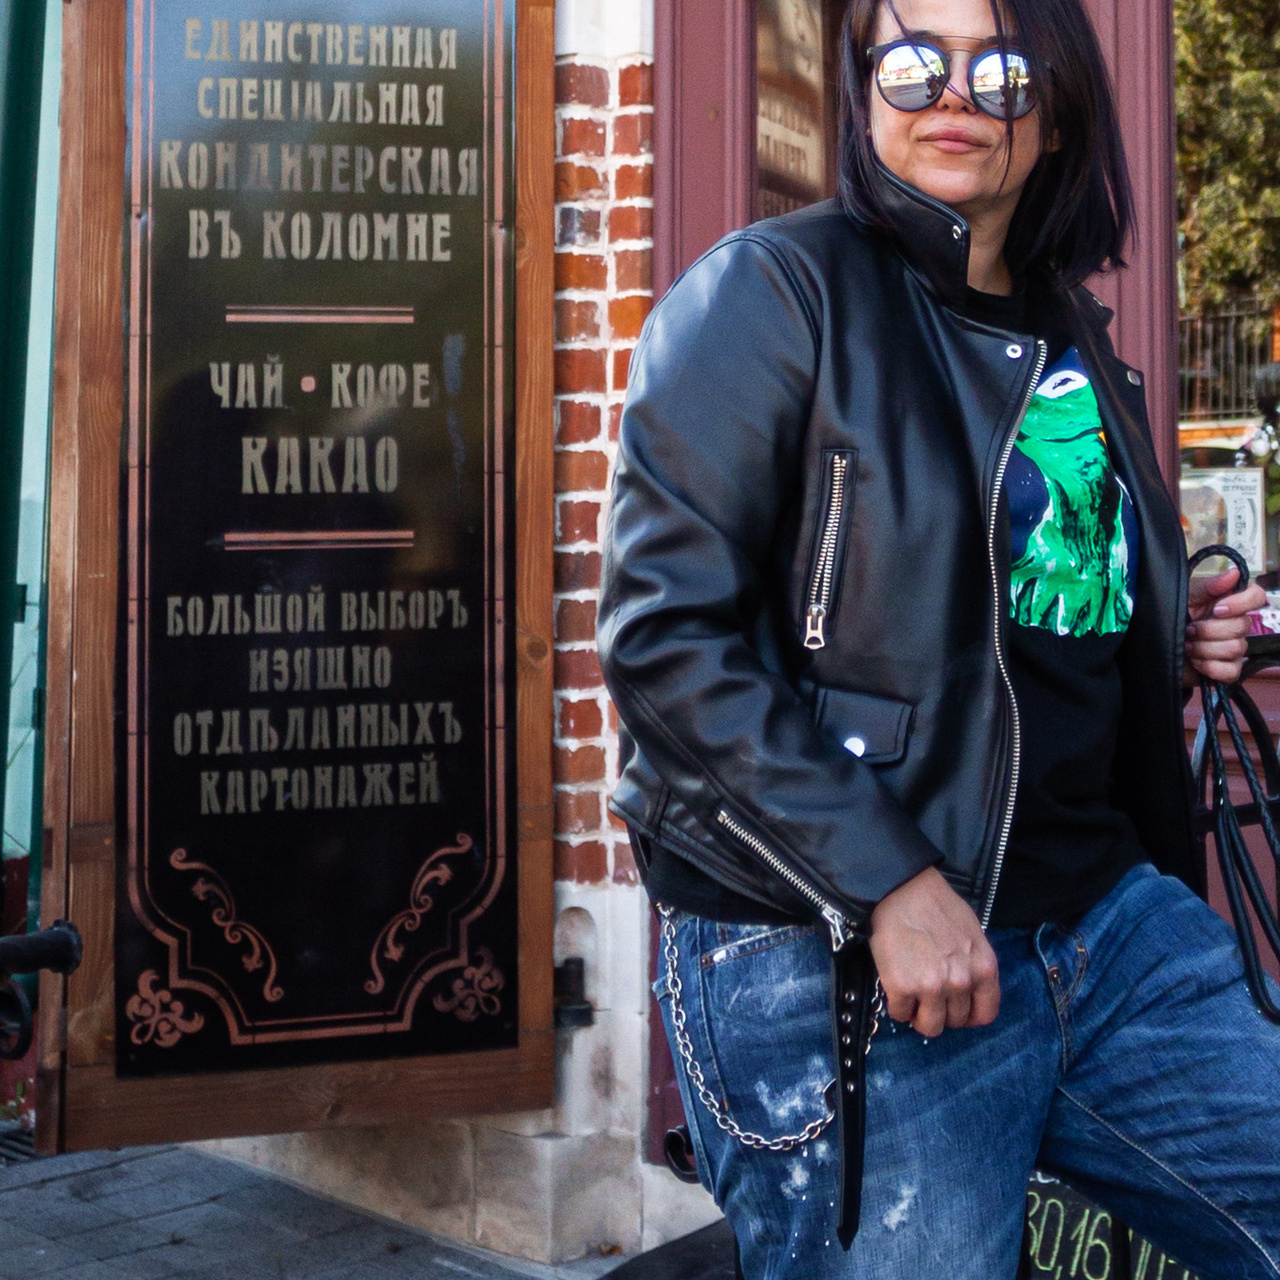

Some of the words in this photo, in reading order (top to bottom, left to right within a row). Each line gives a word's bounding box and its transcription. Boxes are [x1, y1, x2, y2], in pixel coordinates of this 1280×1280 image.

[184, 18, 457, 70] ЕДИНСТВЕННАЯ
[159, 140, 479, 196] КОНДИТЕРСКАЯ
[188, 209, 242, 259] ВЪ
[262, 211, 452, 262] КОЛОМНЕ
[208, 354, 285, 409] ЧАЙ
[330, 362, 431, 409] КОФЕ
[240, 436, 399, 495] КАКАО
[166, 585, 327, 637] БОЛЬШОЙ
[340, 588, 469, 633] ВЫБОРЪ
[249, 644, 392, 692] ИЗЯЩНО
[199, 752, 440, 816] КАРТОНАЖЕЙ
